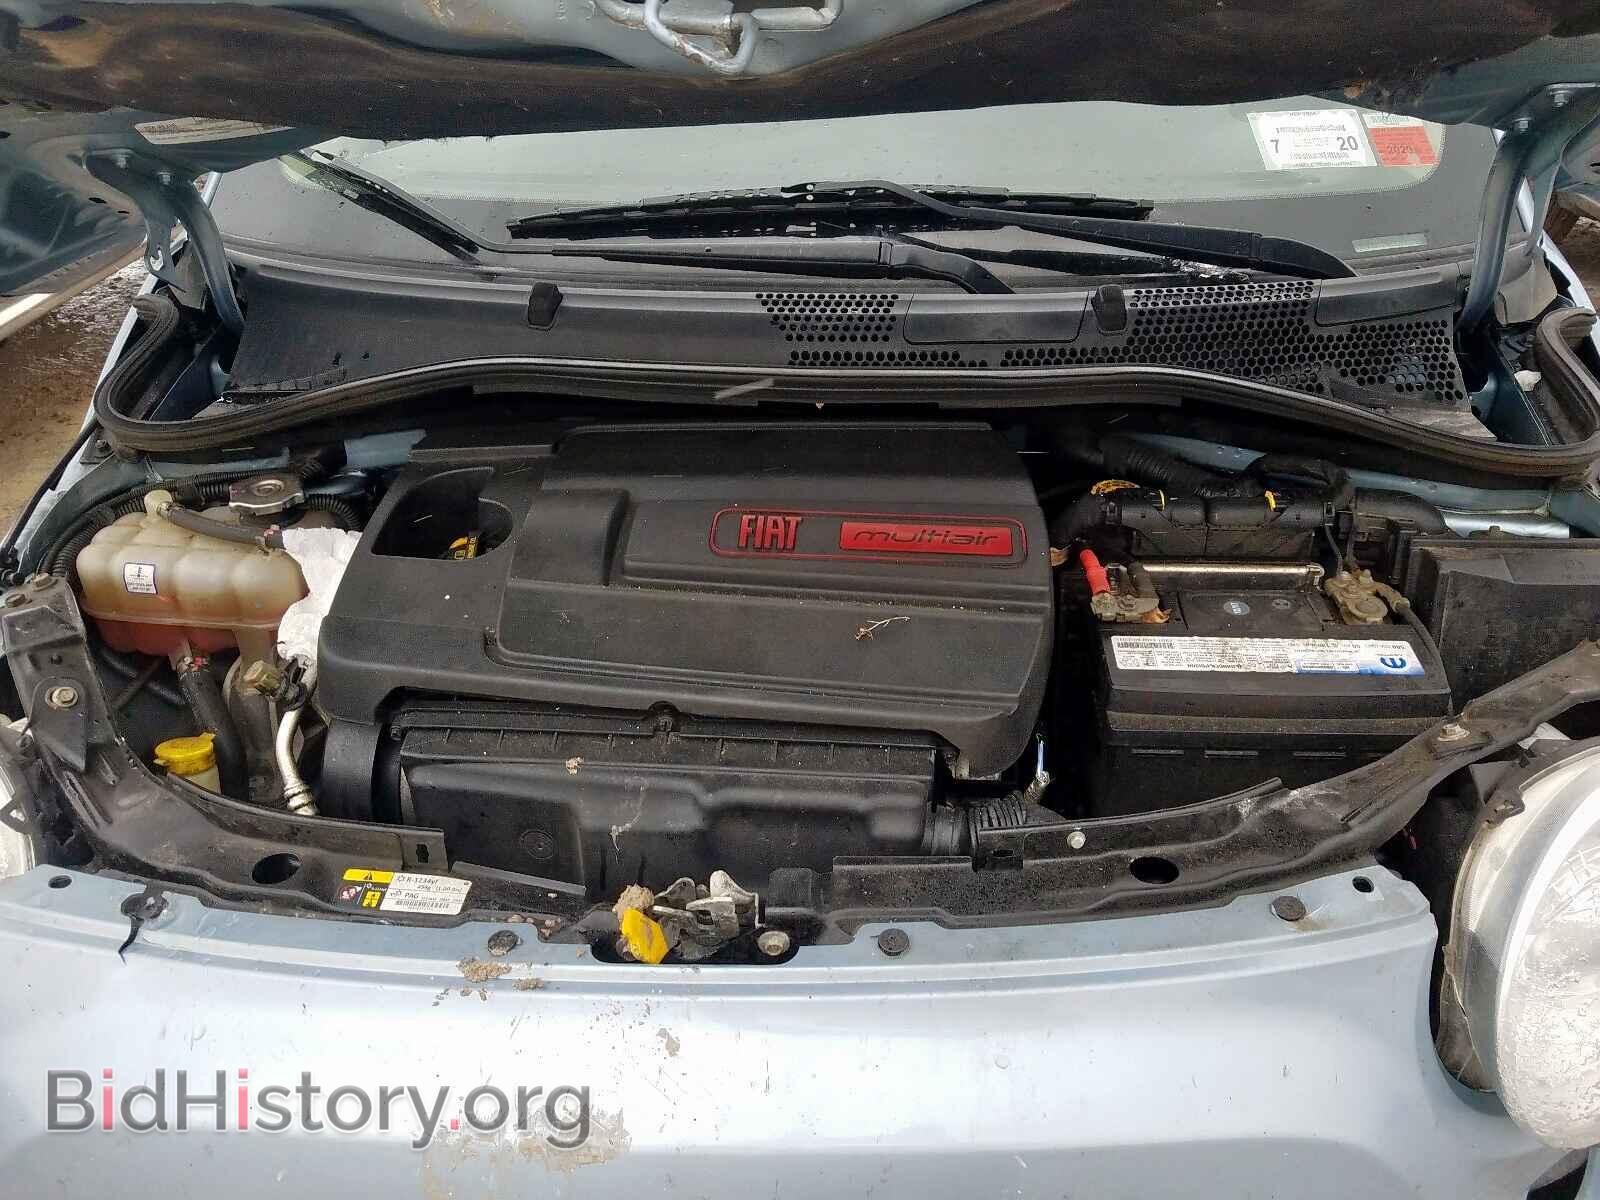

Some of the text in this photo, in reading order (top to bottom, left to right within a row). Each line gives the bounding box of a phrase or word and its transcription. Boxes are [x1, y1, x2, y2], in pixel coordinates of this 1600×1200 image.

[1270, 139, 1280, 154] 7
[1336, 135, 1359, 151] 20
[738, 514, 1001, 551] FIAT multiair
